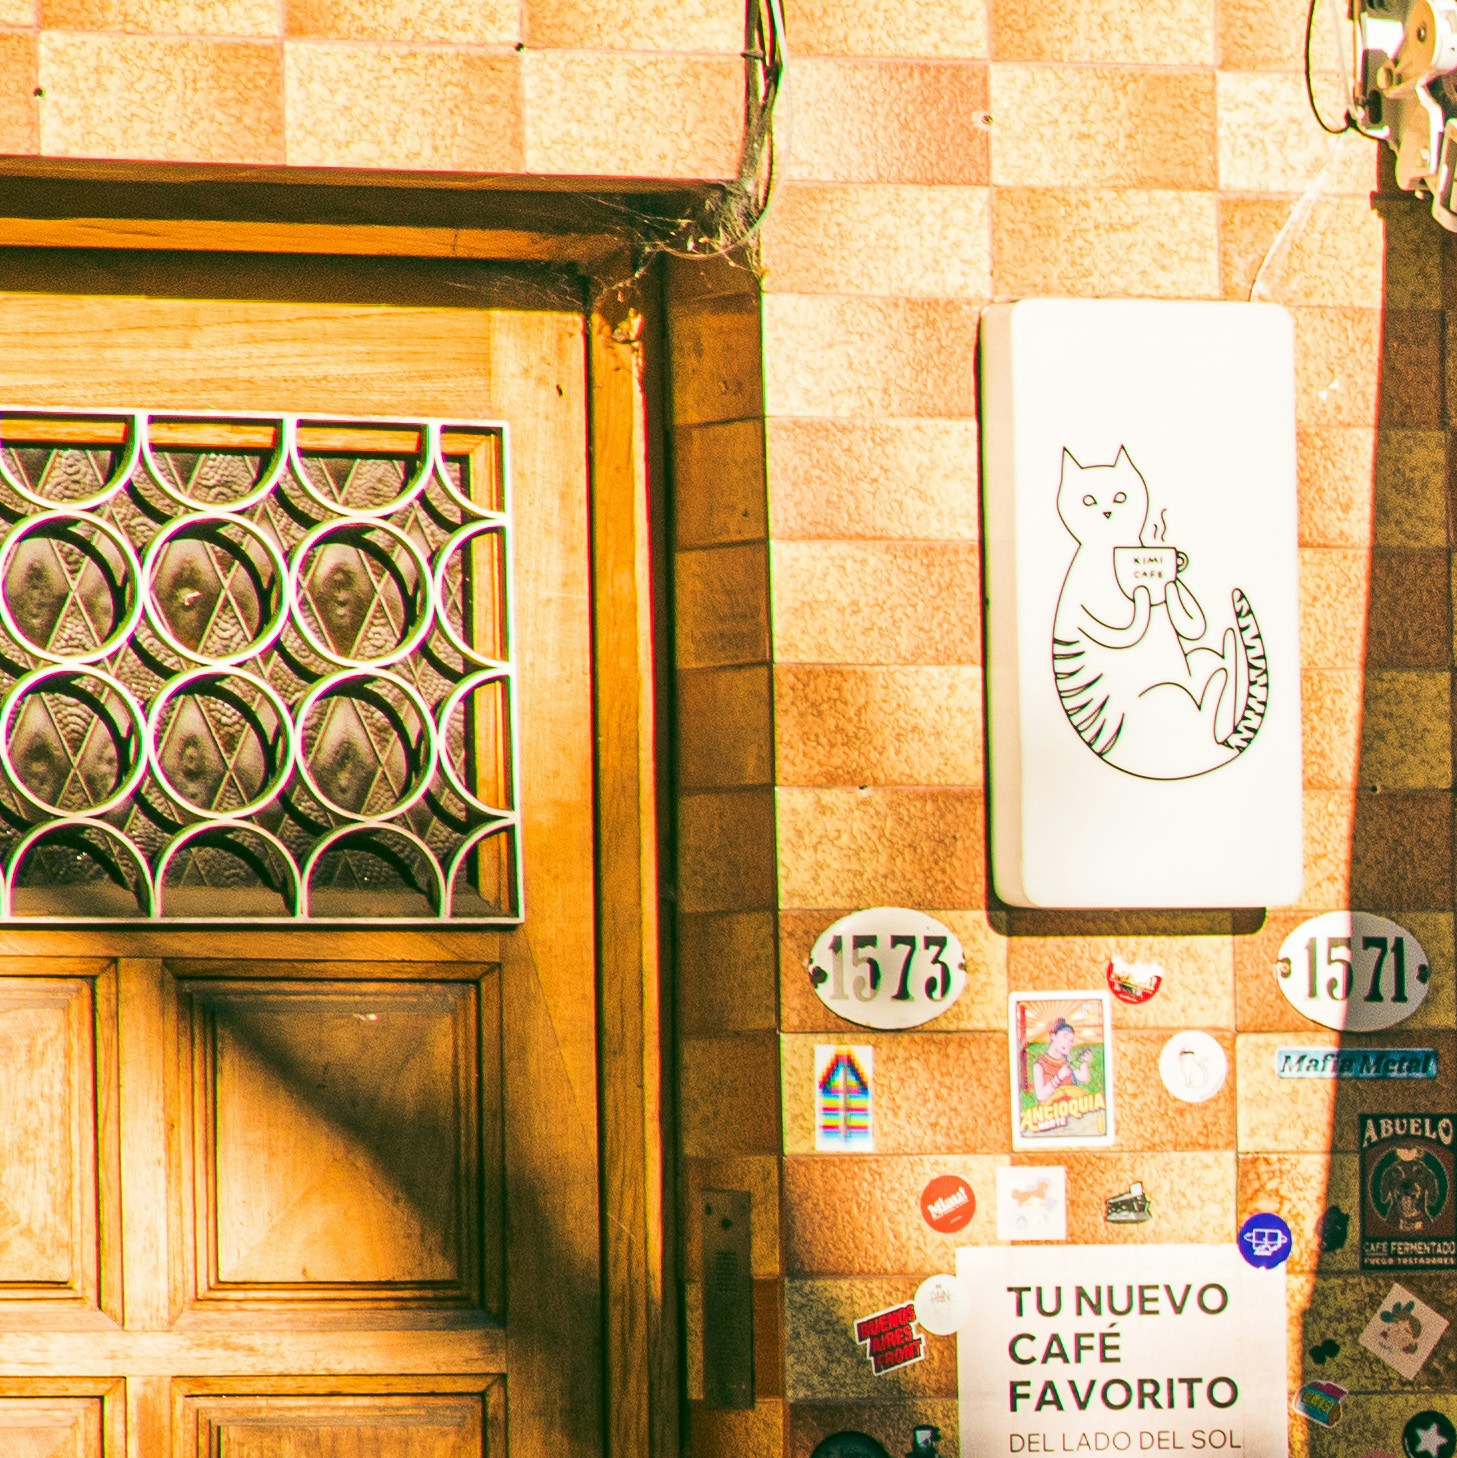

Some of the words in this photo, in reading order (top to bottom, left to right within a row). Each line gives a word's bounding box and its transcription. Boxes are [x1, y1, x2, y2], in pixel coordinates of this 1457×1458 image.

[826, 935, 951, 1002] 1573
[1303, 936, 1409, 1003] 1571
[1362, 1118, 1454, 1147] ABUELO
[1007, 1285, 1062, 1318] TU
[1075, 1283, 1229, 1316] NUEVO
[1008, 1322, 1122, 1365] CAFÉ
[1008, 1376, 1239, 1413] FAVORITO
[1009, 1432, 1055, 1453] DEL
[1062, 1430, 1131, 1452] LADO
[1139, 1429, 1184, 1450] DEL
[1191, 1429, 1242, 1449] SOL
